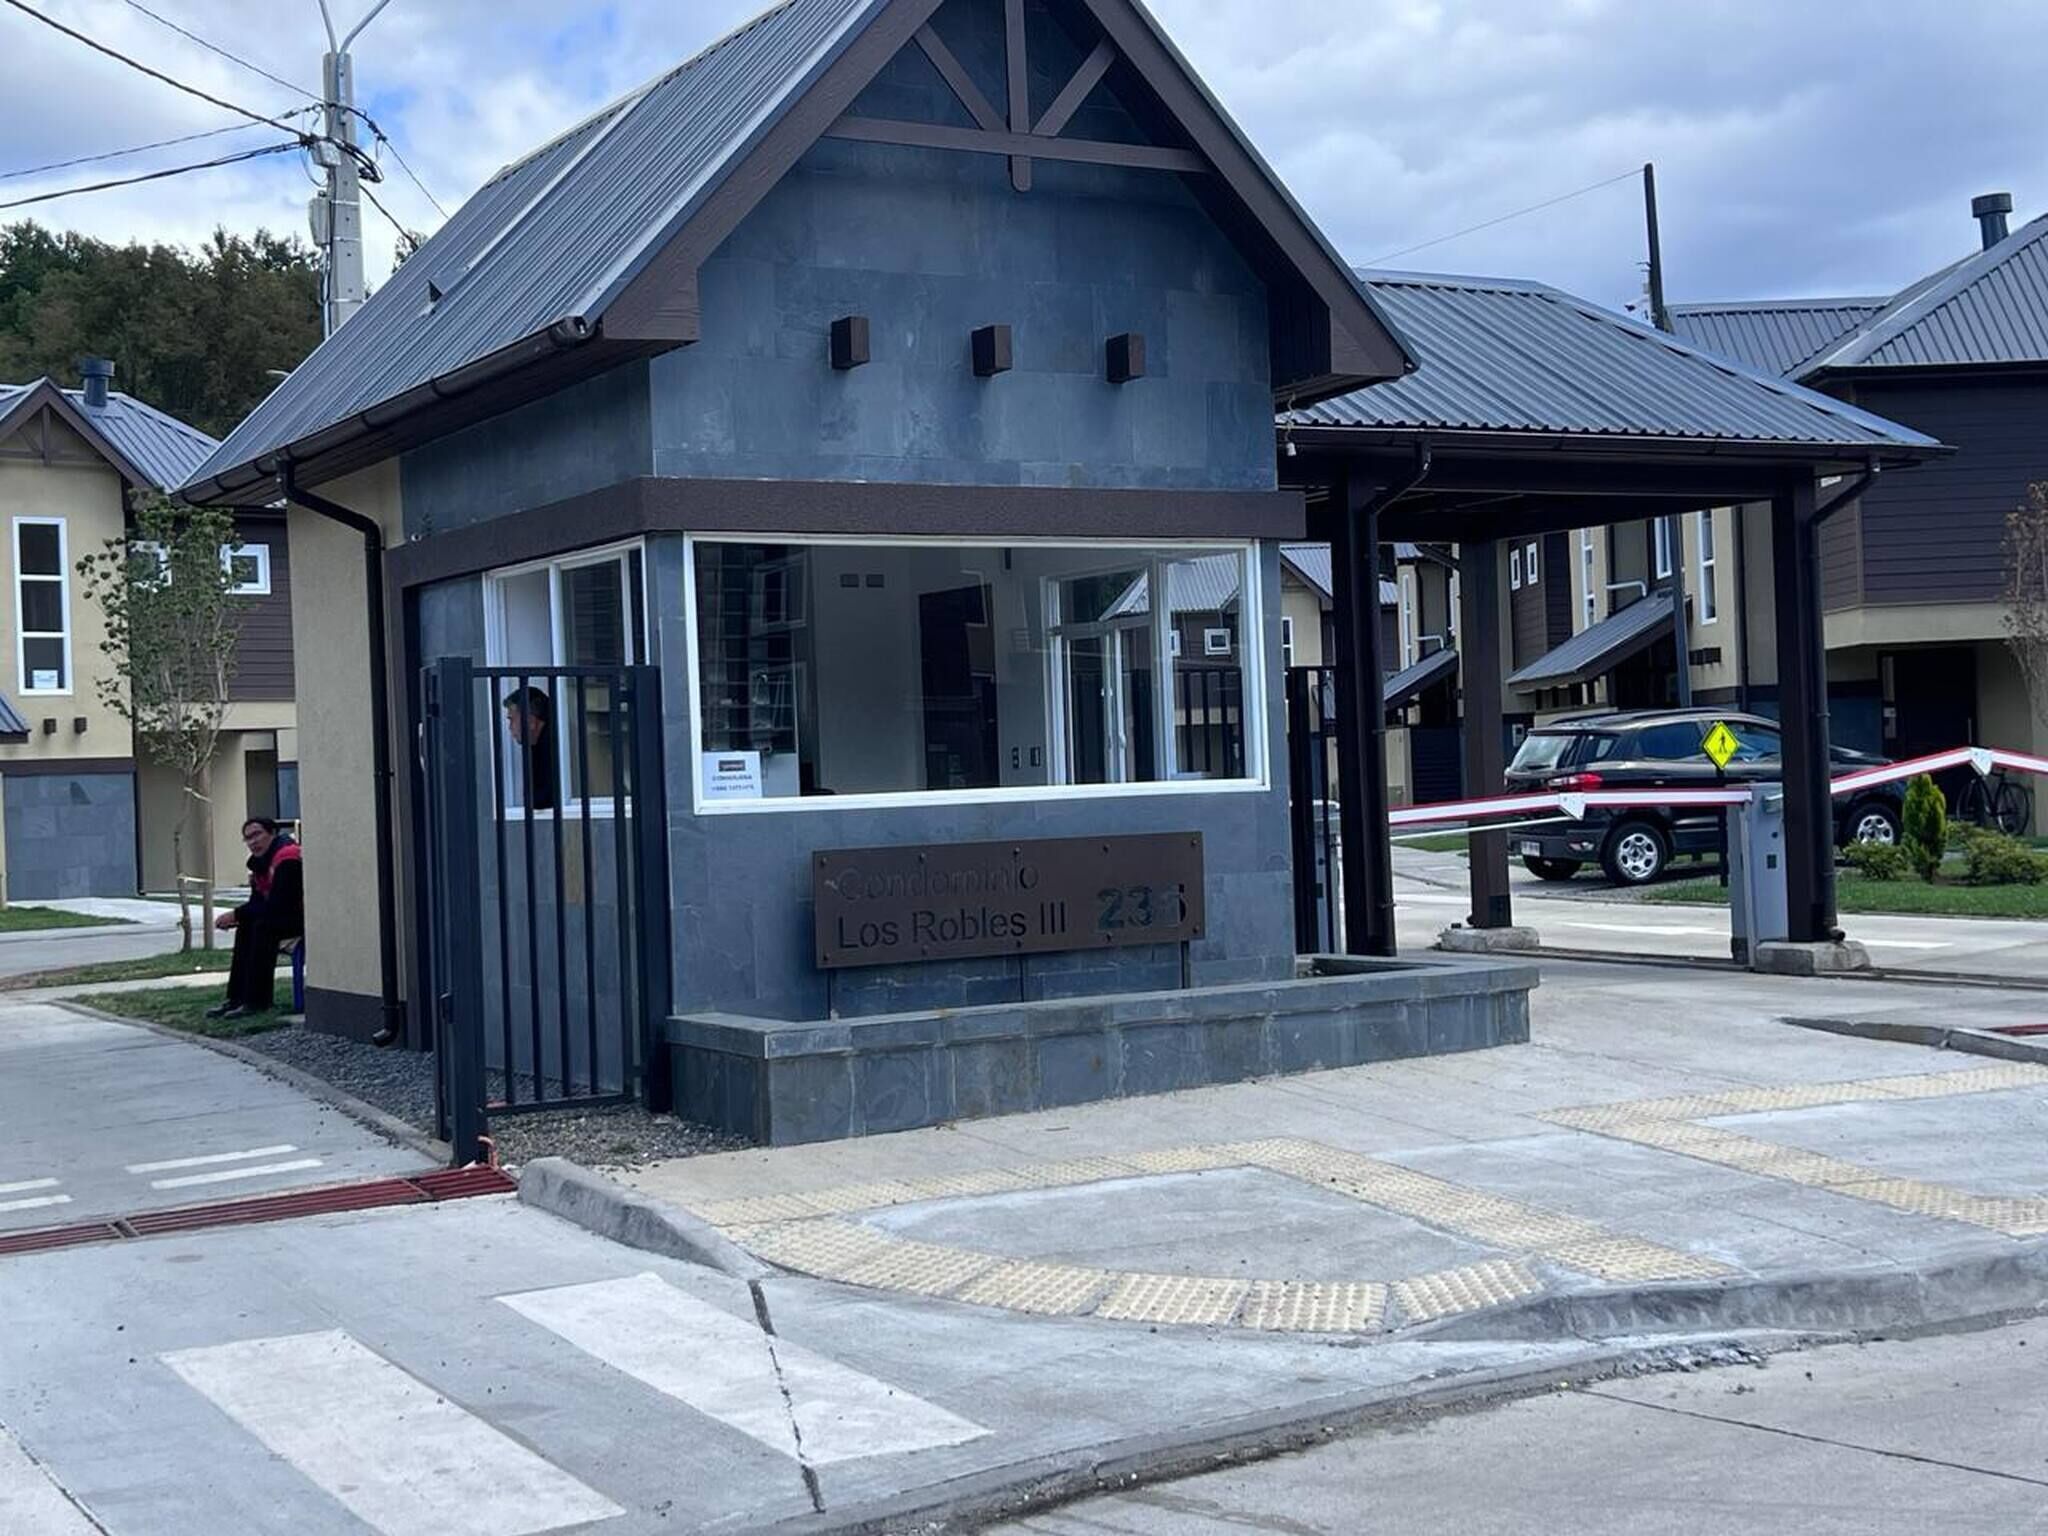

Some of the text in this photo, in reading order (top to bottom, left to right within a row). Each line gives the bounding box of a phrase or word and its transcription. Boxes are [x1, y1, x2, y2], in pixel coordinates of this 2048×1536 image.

[839, 861, 1039, 901] Condominio
[838, 901, 1066, 949] Los Robles III
